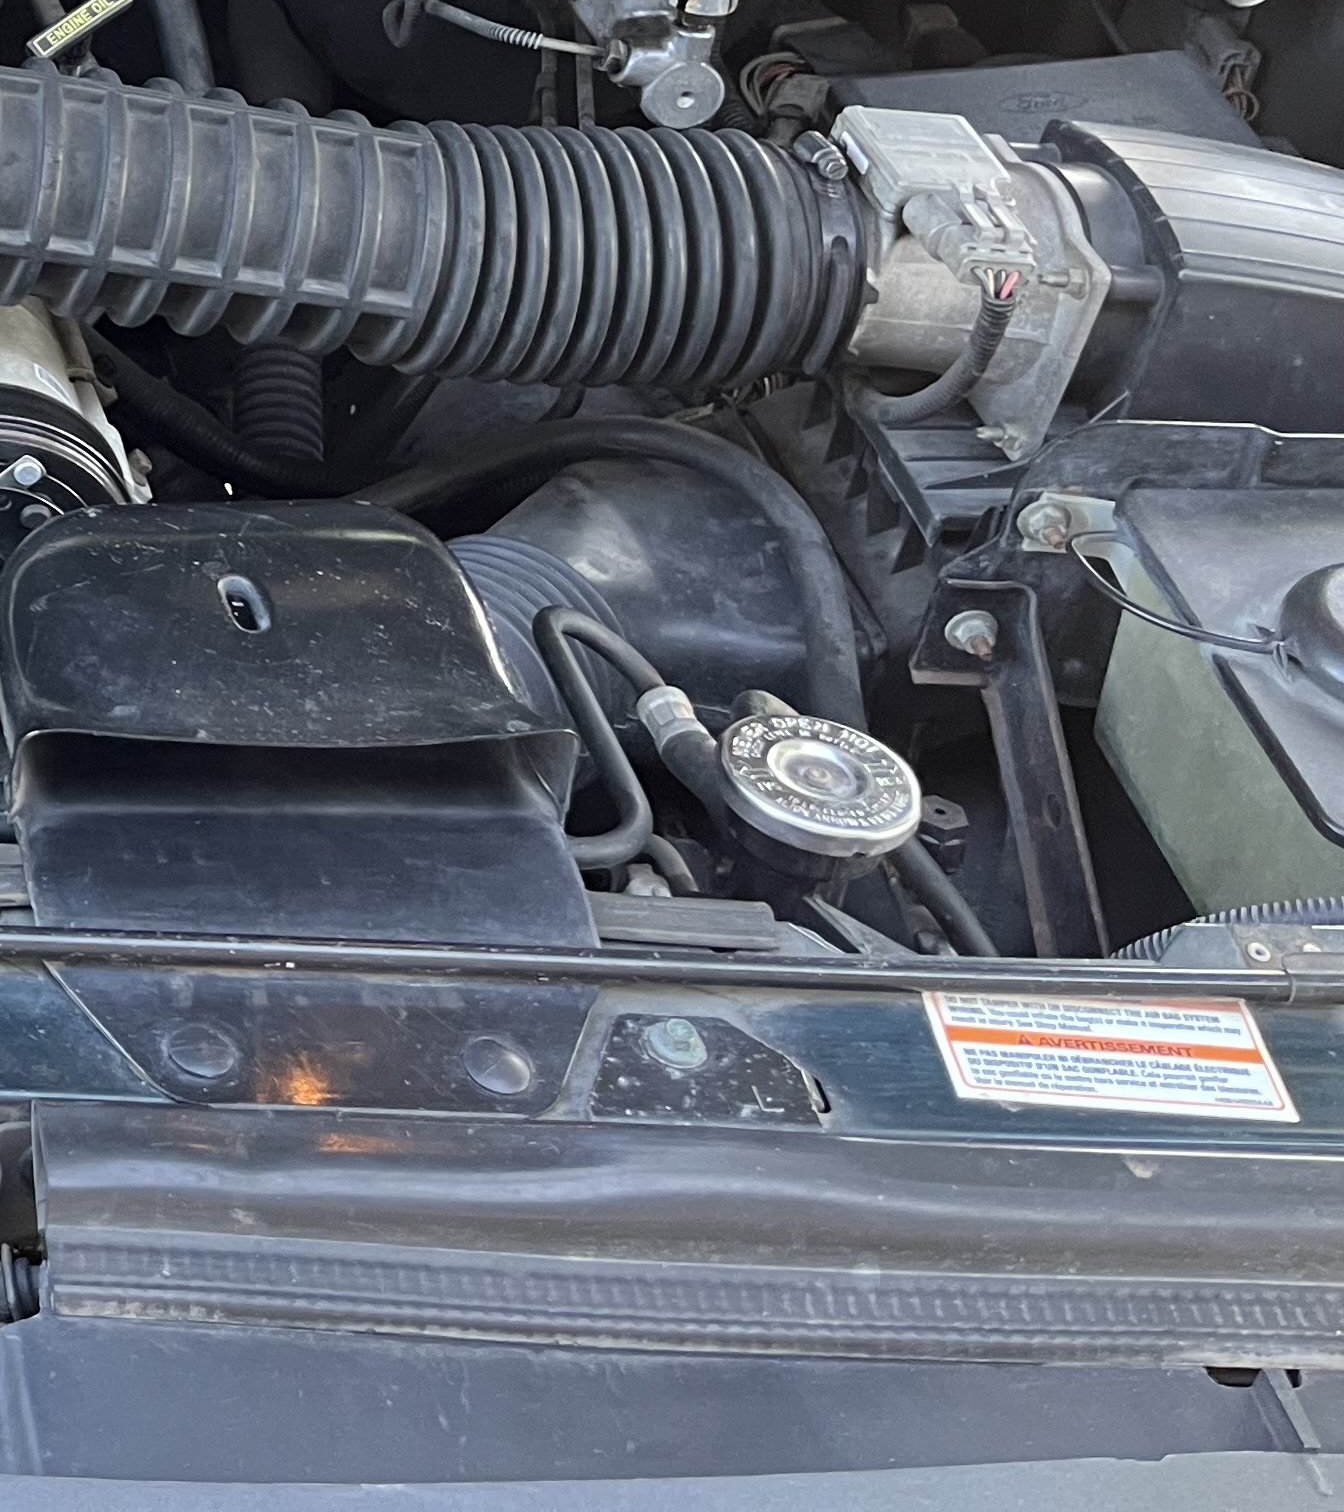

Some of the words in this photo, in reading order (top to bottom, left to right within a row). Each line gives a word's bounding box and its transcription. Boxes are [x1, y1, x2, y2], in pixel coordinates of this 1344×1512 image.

[45, 7, 92, 46] ENGINE
[1182, 1013, 1220, 1024] SYSTEM
[1038, 1036, 1193, 1058] AVERTISSEMENT
[751, 1085, 785, 1113] L
